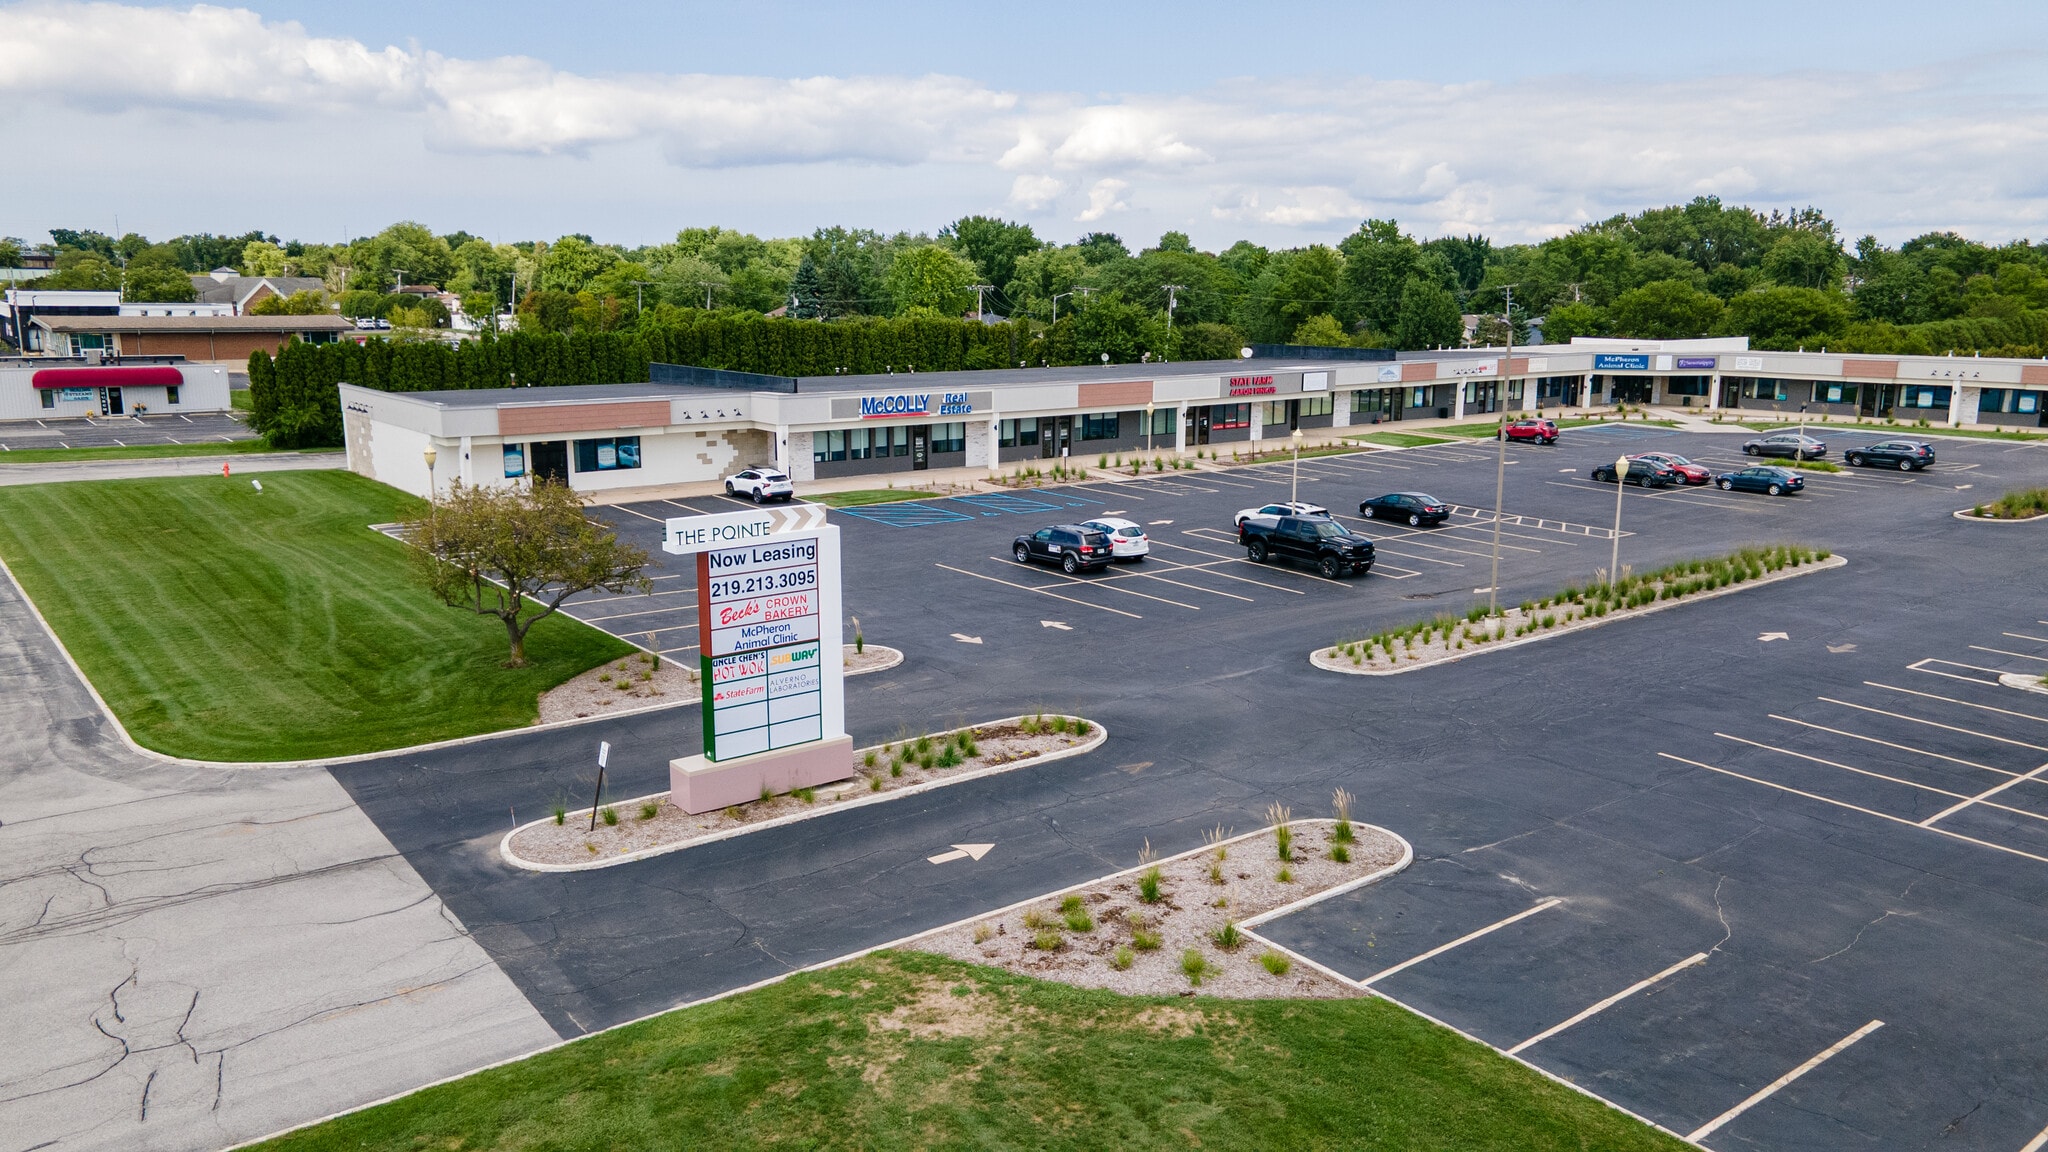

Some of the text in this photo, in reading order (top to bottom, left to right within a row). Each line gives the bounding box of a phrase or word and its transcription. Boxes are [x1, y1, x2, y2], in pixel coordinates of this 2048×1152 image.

[1230, 377, 1251, 387] STATE
[861, 394, 930, 415] McCOLLY
[944, 392, 968, 403] Real
[940, 403, 972, 415] Estate
[676, 521, 771, 546] THE POINTE
[710, 544, 815, 569] Now Leasing
[711, 570, 815, 597] 219.213.3095
[765, 594, 807, 609] CROWN
[719, 599, 760, 625] Beck's
[764, 605, 809, 621] BAKERY
[741, 623, 791, 638] McPheron
[734, 632, 799, 651] Animal Clinic
[712, 651, 765, 667] UNCLE CHEN'S
[770, 648, 818, 666] SUBWAY
[713, 661, 765, 681] HOT WOK
[769, 679, 819, 694] LABORATORIES
[770, 674, 807, 686] ALVERNO
